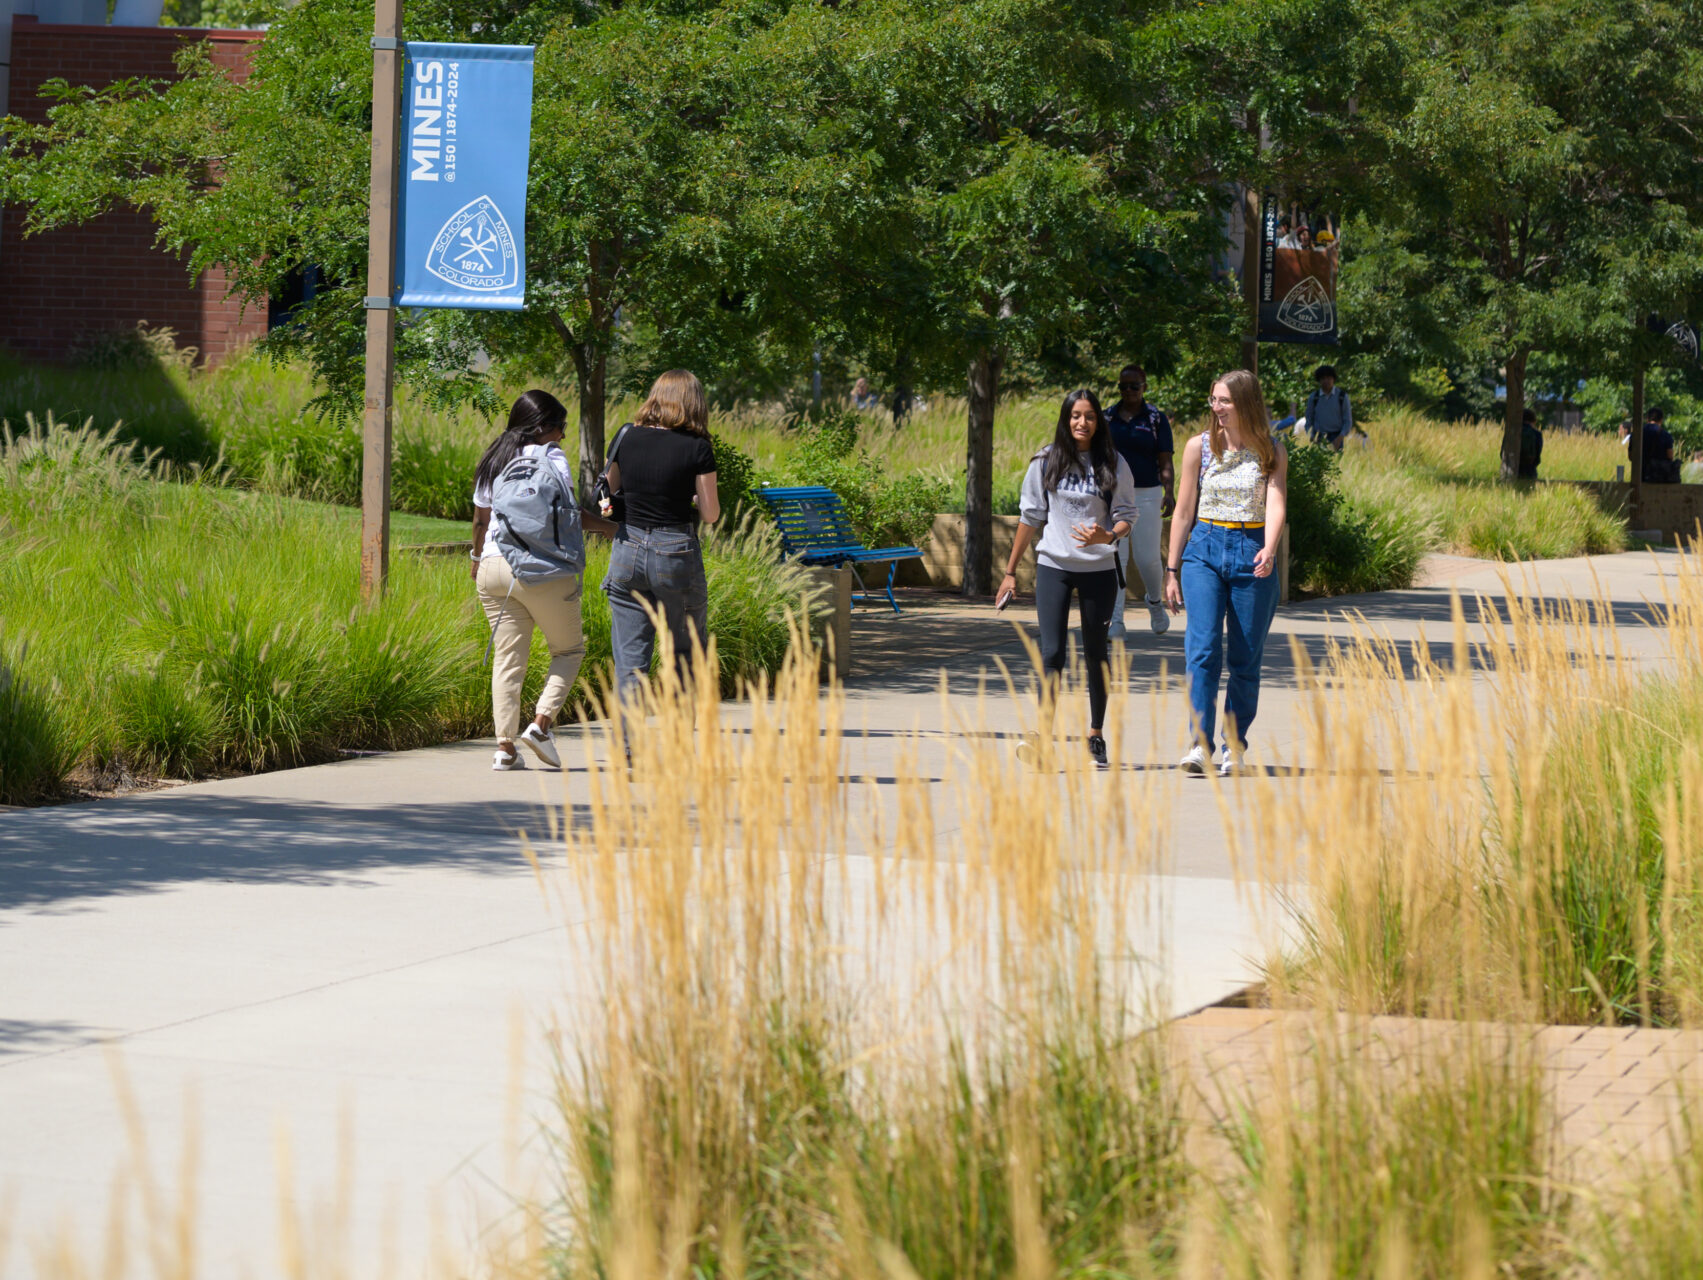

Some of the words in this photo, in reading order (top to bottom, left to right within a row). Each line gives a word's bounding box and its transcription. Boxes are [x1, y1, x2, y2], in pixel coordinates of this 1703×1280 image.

[446, 62, 459, 136] 1874-2024
[411, 61, 443, 181] MINES
[435, 211, 473, 253] SCHOOL
[478, 202, 490, 210] OF
[495, 220, 513, 258] MINES
[461, 259, 484, 273] 1874
[1265, 246, 1273, 270] 150
[438, 266, 504, 287] COLORADO
[1263, 272, 1272, 301] MINES
[1056, 472, 1103, 498] INE
